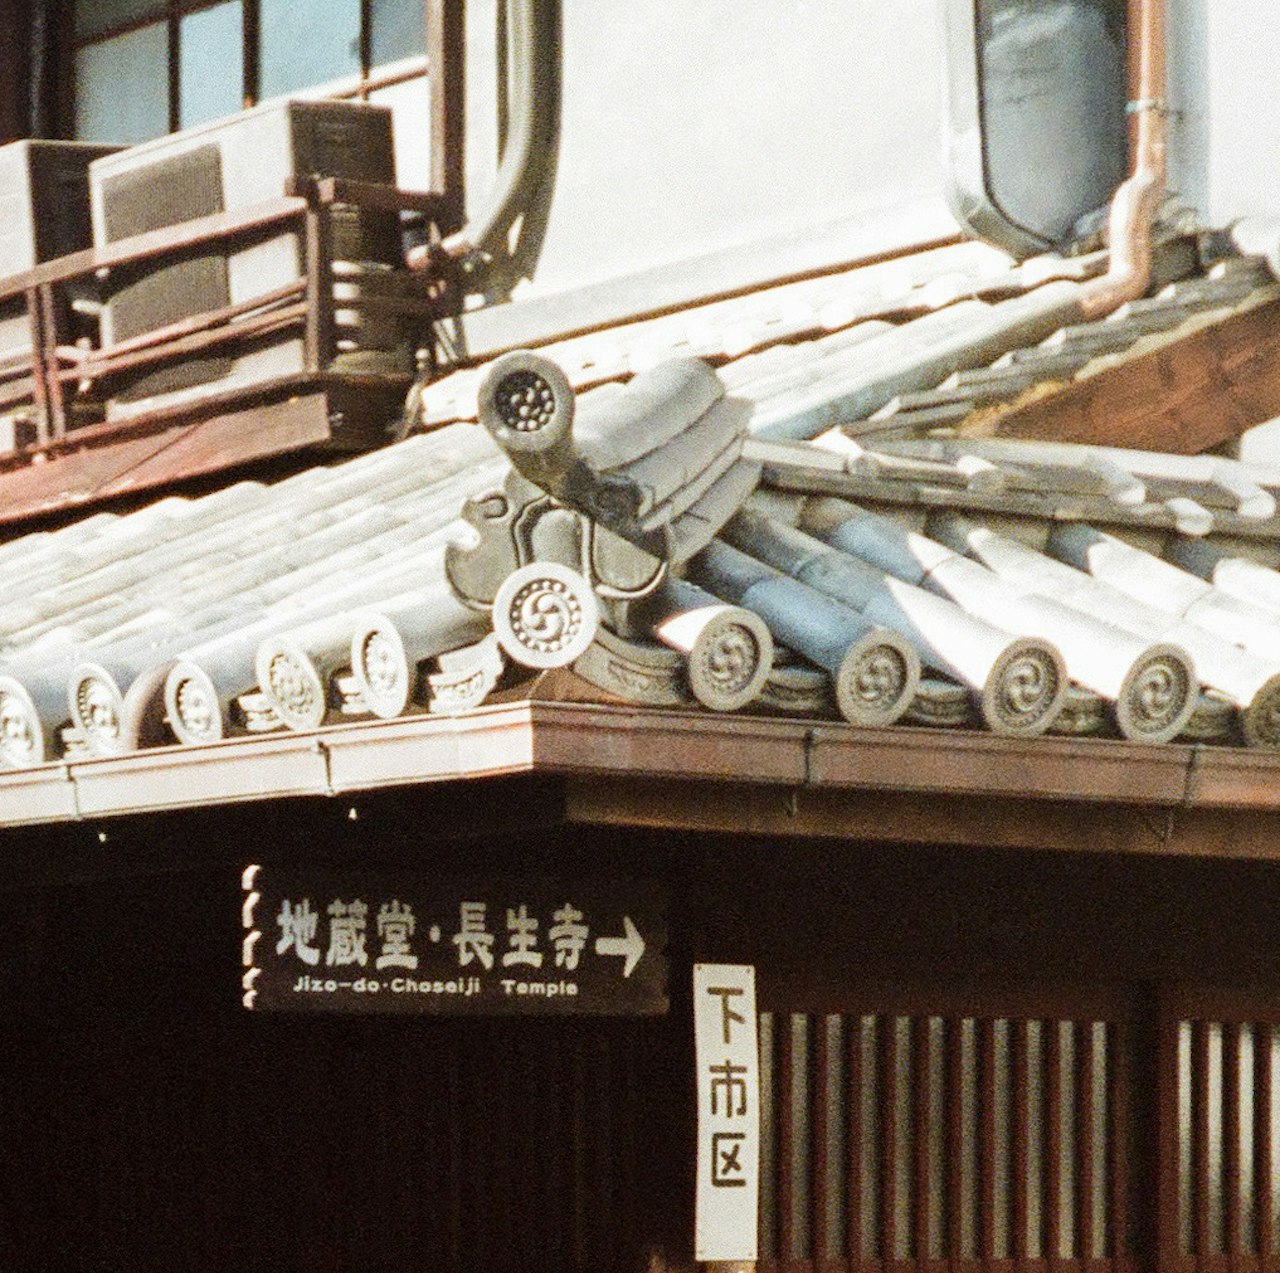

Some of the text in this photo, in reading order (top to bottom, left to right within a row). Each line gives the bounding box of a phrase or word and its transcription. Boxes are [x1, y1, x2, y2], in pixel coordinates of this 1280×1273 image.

[500, 978, 578, 998] Temple
[707, 986, 748, 1188] 下市区
